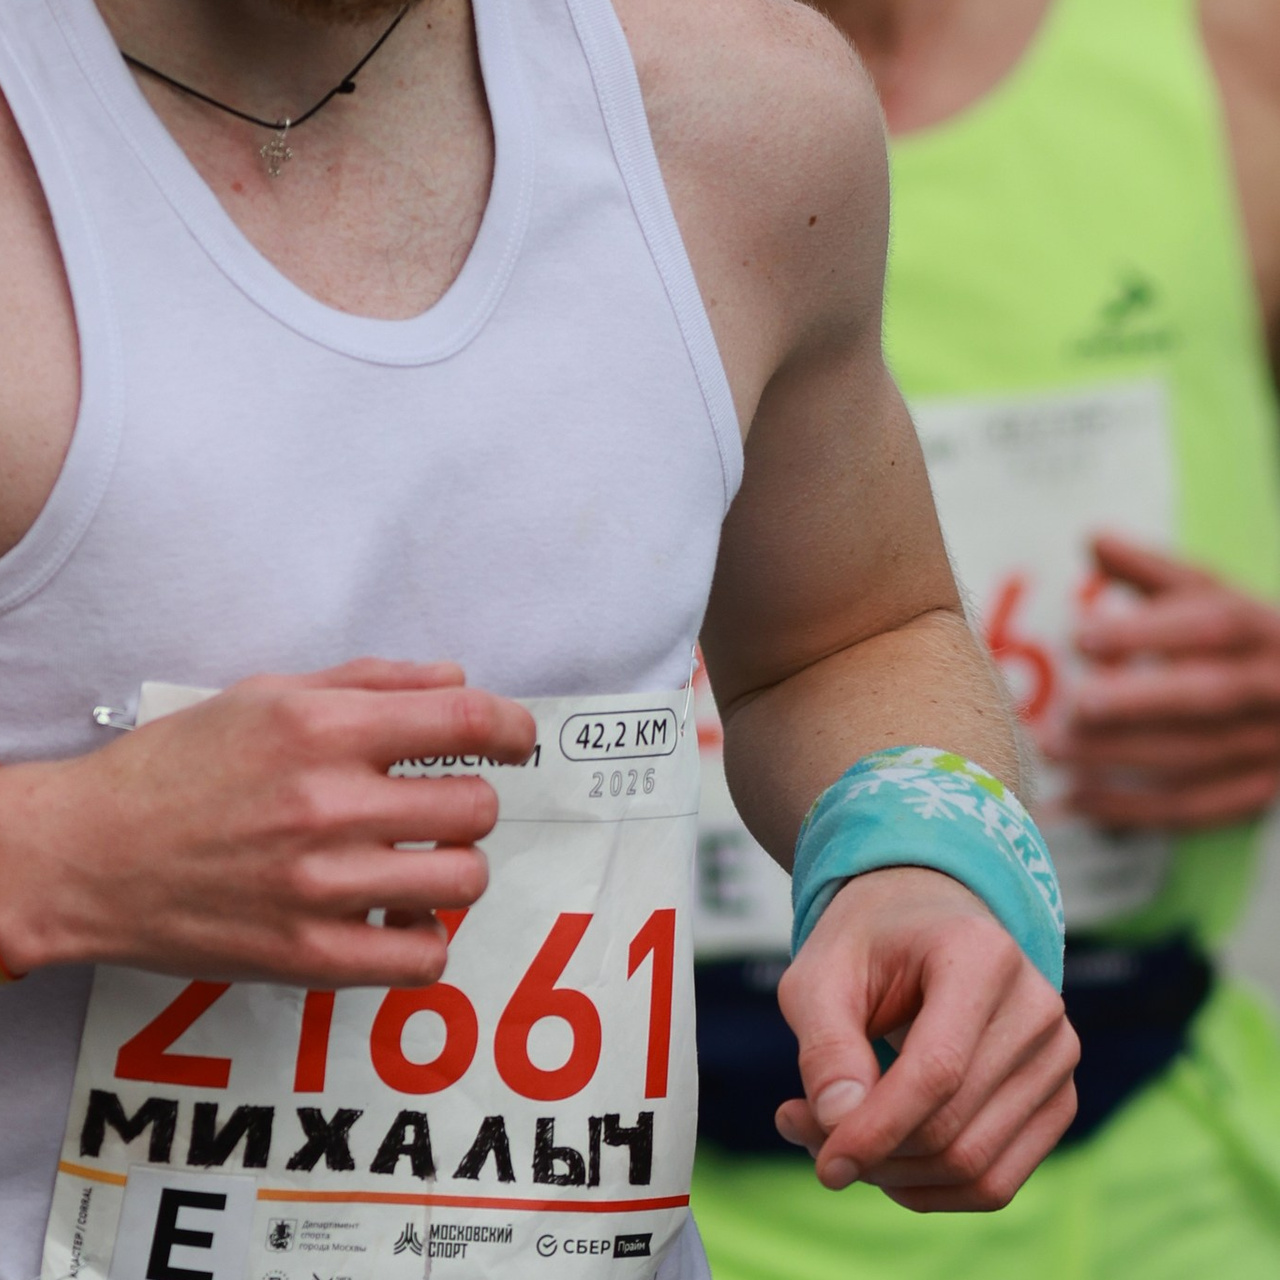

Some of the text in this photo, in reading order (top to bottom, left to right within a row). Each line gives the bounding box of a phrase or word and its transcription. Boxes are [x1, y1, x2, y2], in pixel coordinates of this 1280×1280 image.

[576, 721, 626, 752] 42,2
[588, 768, 656, 798] 2026
[114, 908, 676, 1102] 21661
[80, 1089, 654, 1187] МИХАЛЫЧ
[78, 1187, 92, 1224] CORRAL
[300, 1232, 330, 1242] спорта
[429, 1224, 513, 1244] МОСКОВСКИЙ
[563, 1238, 646, 1255] СБЕР Прайм
[331, 1243, 367, 1253] Москвы
[428, 1242, 468, 1259] СПОРТ
